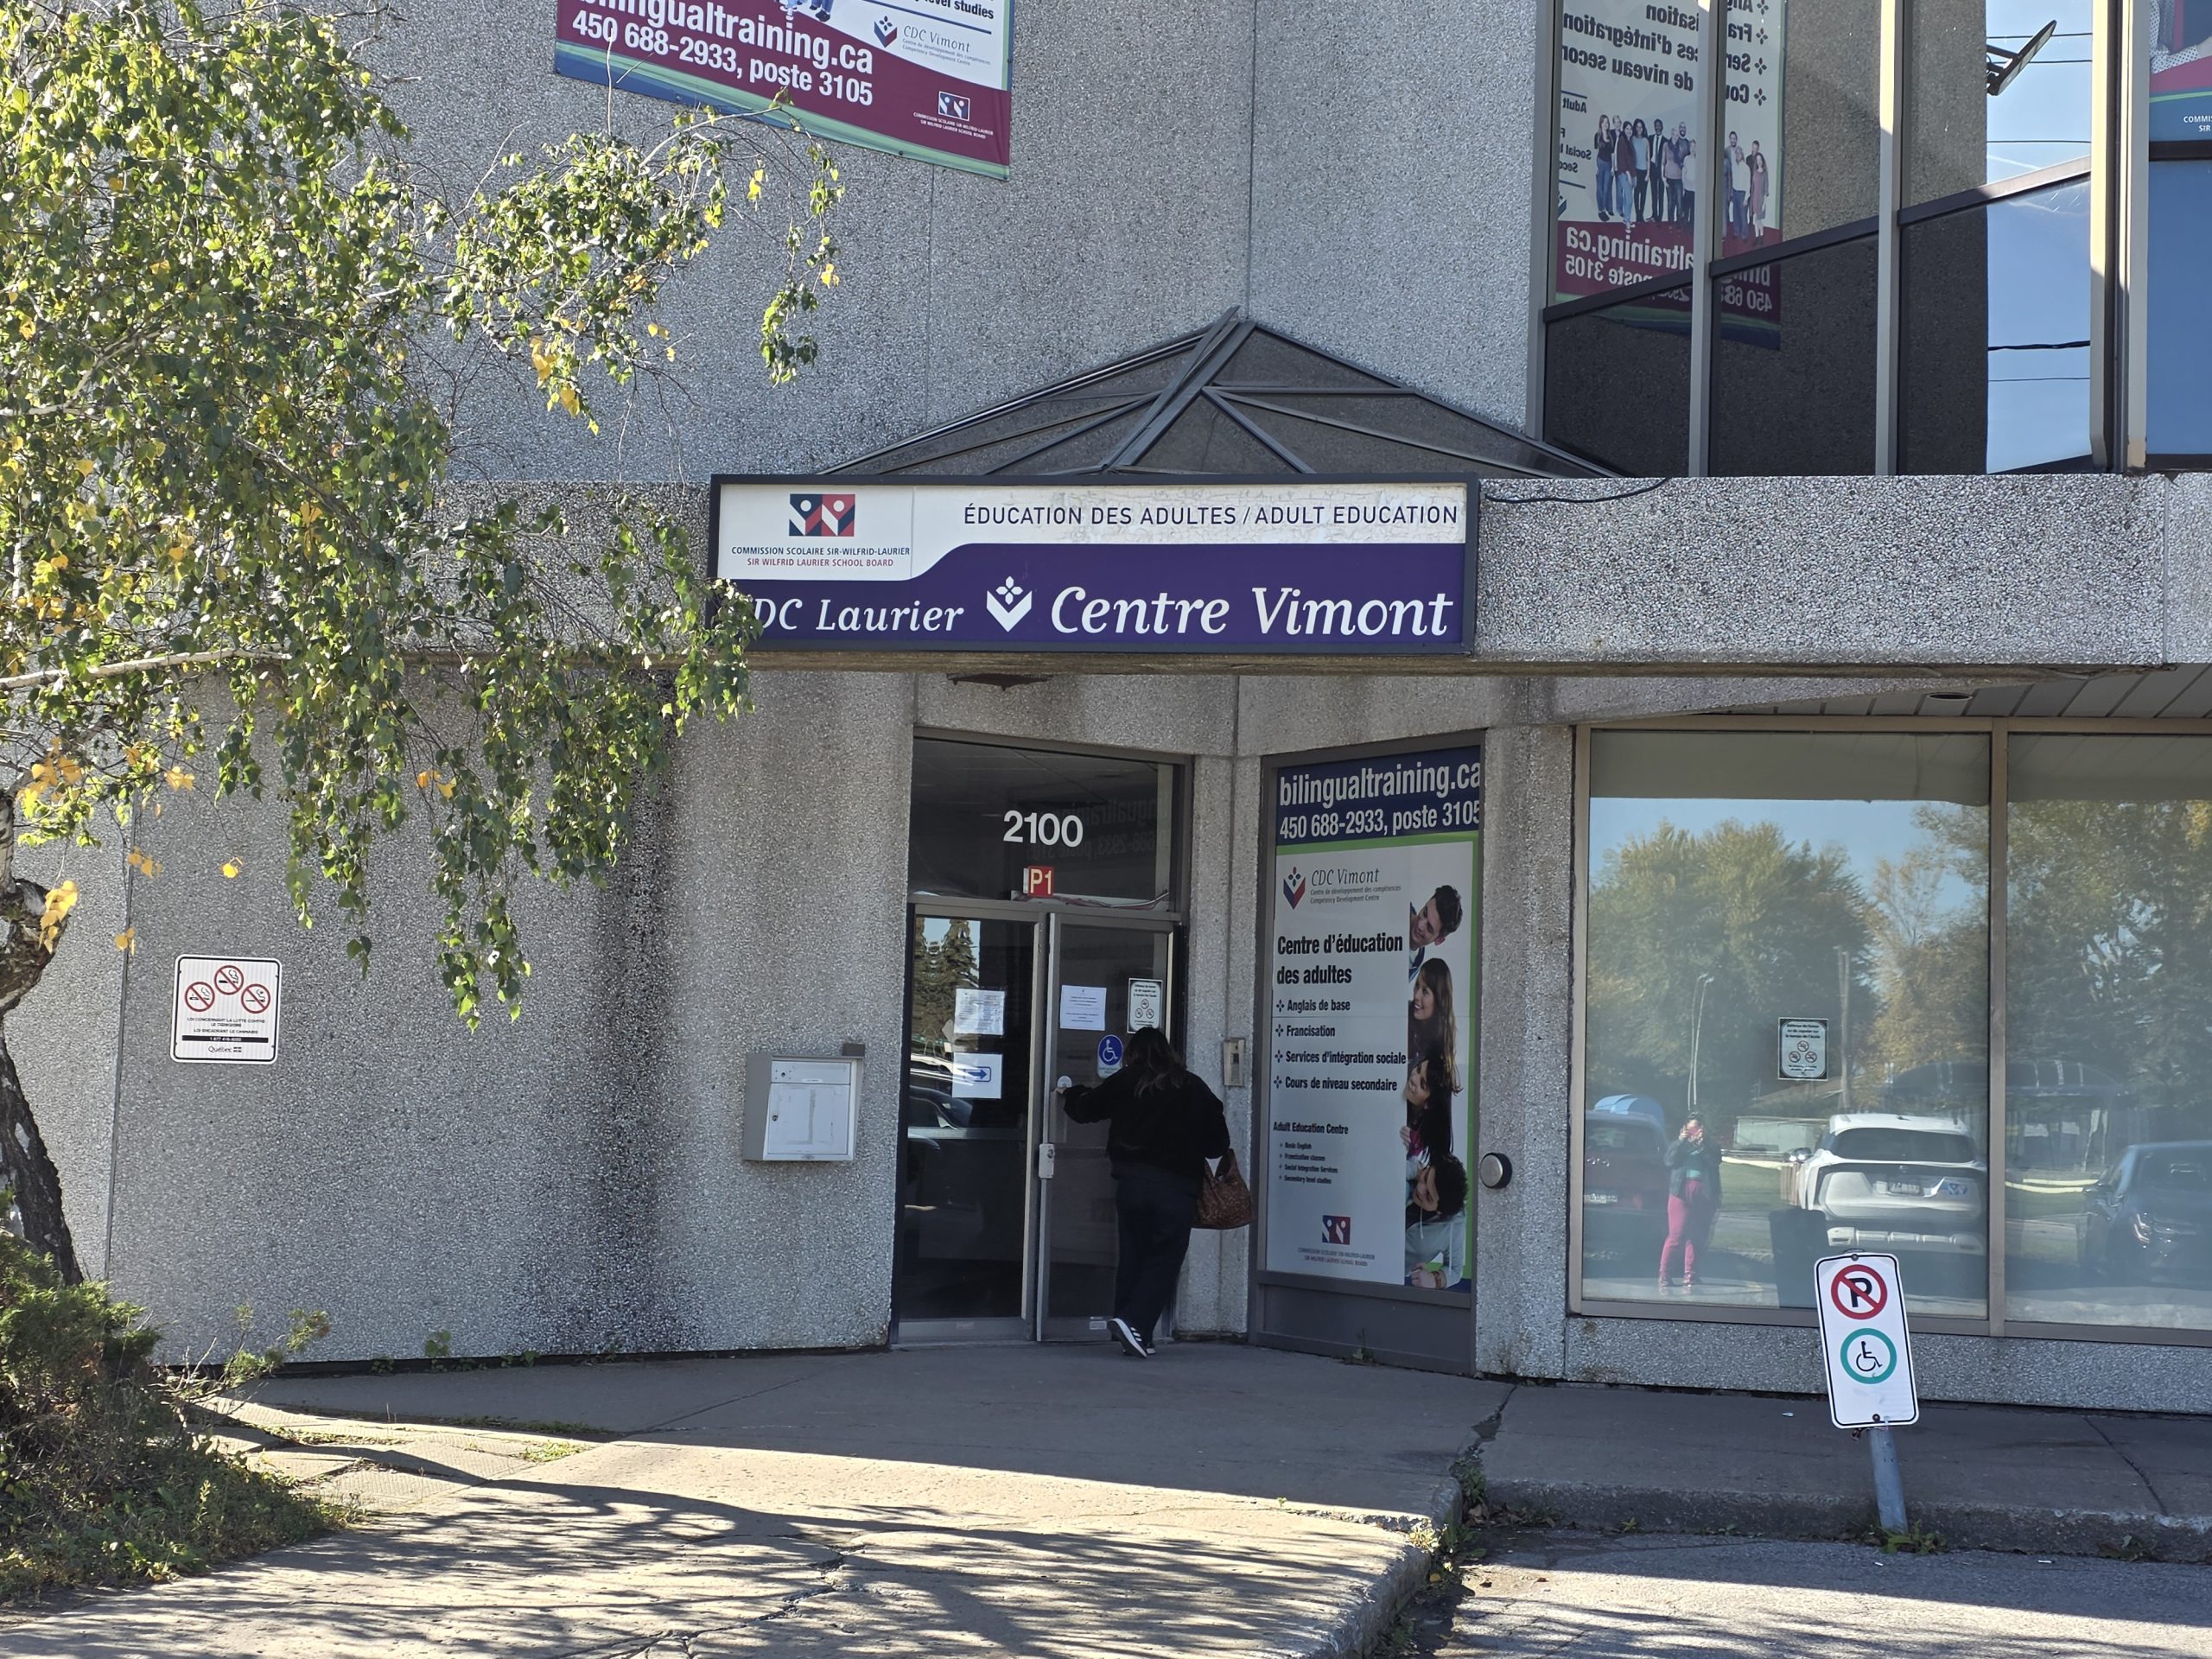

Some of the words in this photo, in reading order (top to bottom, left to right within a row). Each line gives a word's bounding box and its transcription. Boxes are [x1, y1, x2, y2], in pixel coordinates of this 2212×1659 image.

[954, 1, 994, 19] studies
[581, 0, 873, 74] gualtraining.ca
[903, 26, 926, 41] CDC
[930, 31, 970, 53] Vimont
[572, 10, 618, 42] 450
[625, 22, 742, 79] 688-2933,
[749, 58, 812, 91] poste
[819, 72, 873, 105] 3105
[964, 503, 1081, 524] ÉDUCATION
[1091, 507, 1131, 524] DES
[1140, 507, 1236, 524] ADULTES
[1255, 506, 1325, 524] ADULT
[1333, 505, 1458, 524] EDUCATION
[731, 546, 784, 556] COMMISSION
[786, 547, 824, 556] SCOLAIRE
[827, 547, 910, 556] SIR-WILFRID-LAURIER
[753, 598, 803, 631] DC
[816, 599, 964, 632] Laurier
[1051, 586, 1230, 634] Centre
[1252, 587, 1453, 636] Vimont
[1280, 762, 1480, 809] bilingualtraining.ca
[1003, 810, 1084, 848] 2100
[1280, 817, 1306, 839] 450
[1311, 809, 1387, 837] 688-2933,
[1393, 805, 1437, 836] poste
[1030, 868, 1052, 894] P1
[1312, 869, 1334, 886] CDC
[1338, 868, 1380, 885] Vimont
[1277, 935, 1319, 955] Centre
[1323, 932, 1402, 954] d'éducation
[1277, 966, 1300, 984] des
[1303, 965, 1351, 984] adultes
[1287, 999, 1316, 1014] Anglais
[1319, 999, 1328, 1011] de
[1331, 1000, 1351, 1011] base
[1287, 1025, 1335, 1037] Francisation
[1286, 1051, 1319, 1064] Services
[1322, 1051, 1374, 1065] d'intégration
[1376, 1052, 1407, 1065] sociale
[1285, 1076, 1307, 1089] Cours
[1311, 1077, 1320, 1089] de
[1322, 1077, 1349, 1090] niveau
[1351, 1078, 1397, 1090] secondaire
[1273, 1122, 1290, 1132] Adult
[1292, 1122, 1325, 1134] Education
[1326, 1123, 1349, 1135] Centre
